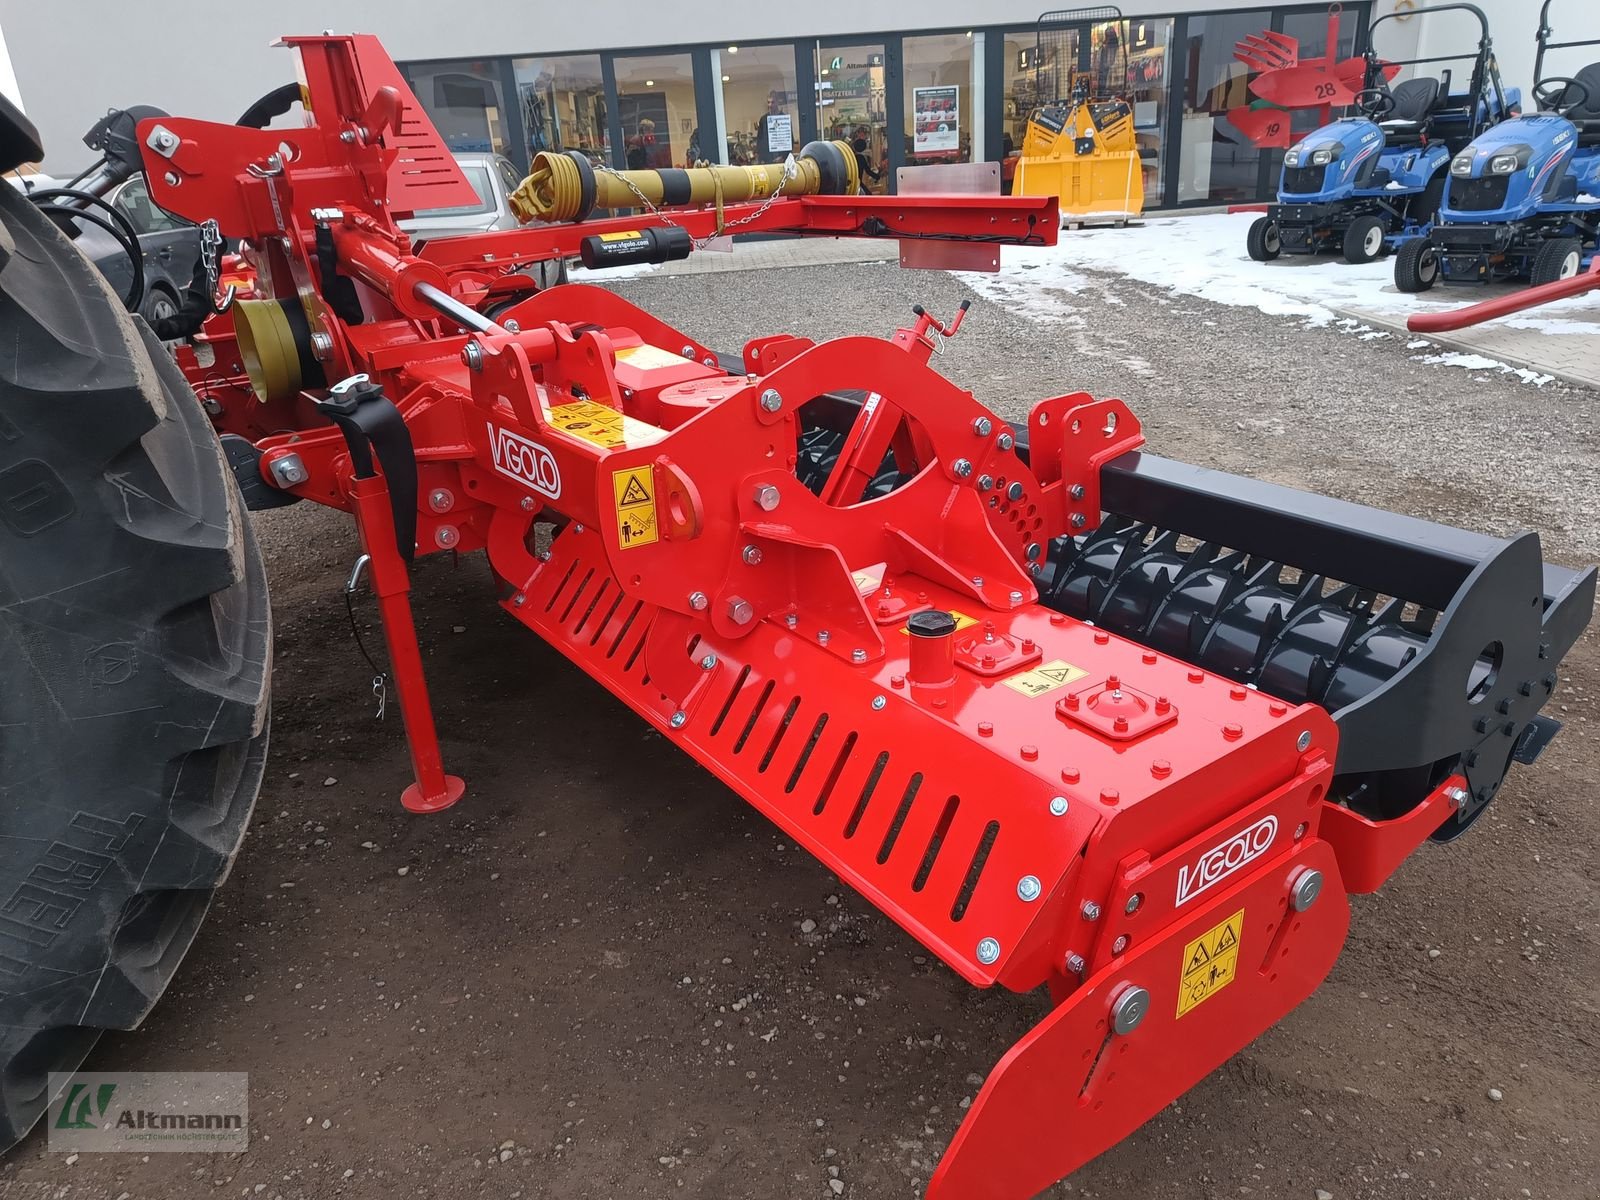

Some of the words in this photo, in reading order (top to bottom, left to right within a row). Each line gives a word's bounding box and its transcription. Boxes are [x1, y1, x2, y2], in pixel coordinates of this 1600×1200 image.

[1315, 82, 1336, 99] 28
[1266, 123, 1280, 137] 19
[1361, 131, 1377, 144] ISEKI
[1552, 130, 1570, 145] ISEKI
[601, 238, 649, 250] www.vigolo.com
[486, 421, 561, 500] VIGOLO
[1175, 815, 1278, 908] VIGOLO
